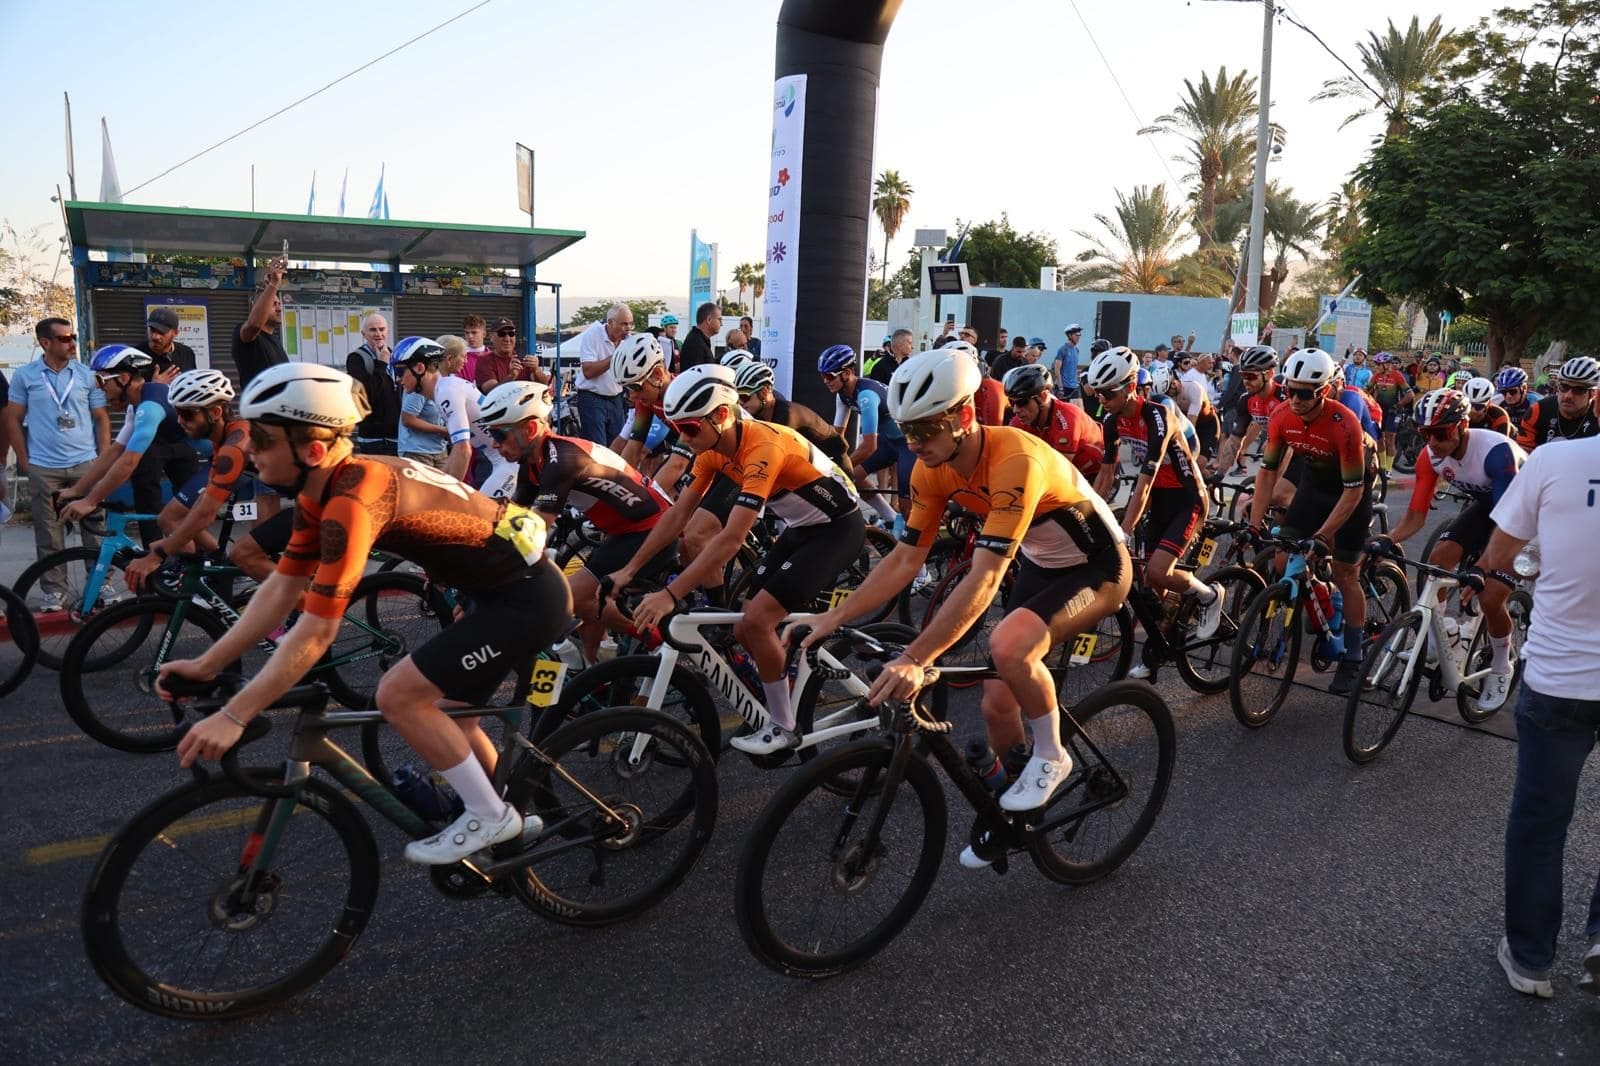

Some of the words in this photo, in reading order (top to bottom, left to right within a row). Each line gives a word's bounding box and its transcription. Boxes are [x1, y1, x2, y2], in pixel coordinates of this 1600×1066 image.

[1232, 319, 1258, 334] יציאה
[279, 404, 345, 426] S-WORKS
[1152, 408, 1166, 437] TREK
[583, 476, 643, 507] TREK
[239, 504, 252, 516] 31
[1201, 543, 1213, 559] 55
[834, 592, 849, 608] 7
[1073, 635, 1090, 656] 75
[461, 644, 502, 671] GVL
[535, 669, 557, 694] 63
[700, 650, 765, 731] CANYON
